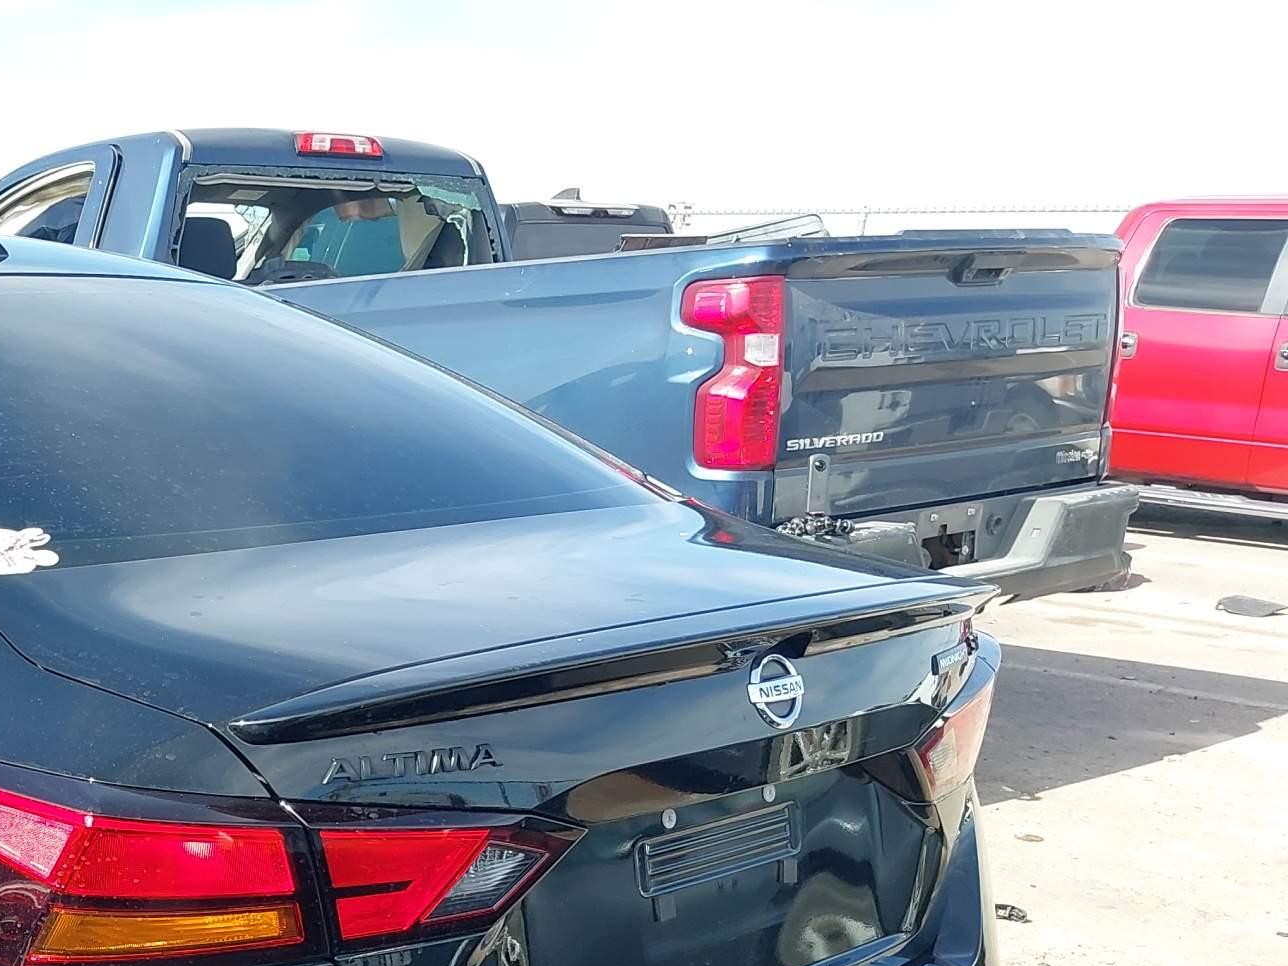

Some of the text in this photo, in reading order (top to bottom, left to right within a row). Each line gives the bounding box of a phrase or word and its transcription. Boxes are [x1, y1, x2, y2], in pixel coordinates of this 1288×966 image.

[821, 313, 1108, 362] CHEVROLET
[785, 431, 884, 451] SILVERADO
[759, 681, 802, 699] NISSAN
[321, 743, 503, 785] ALTIMA
